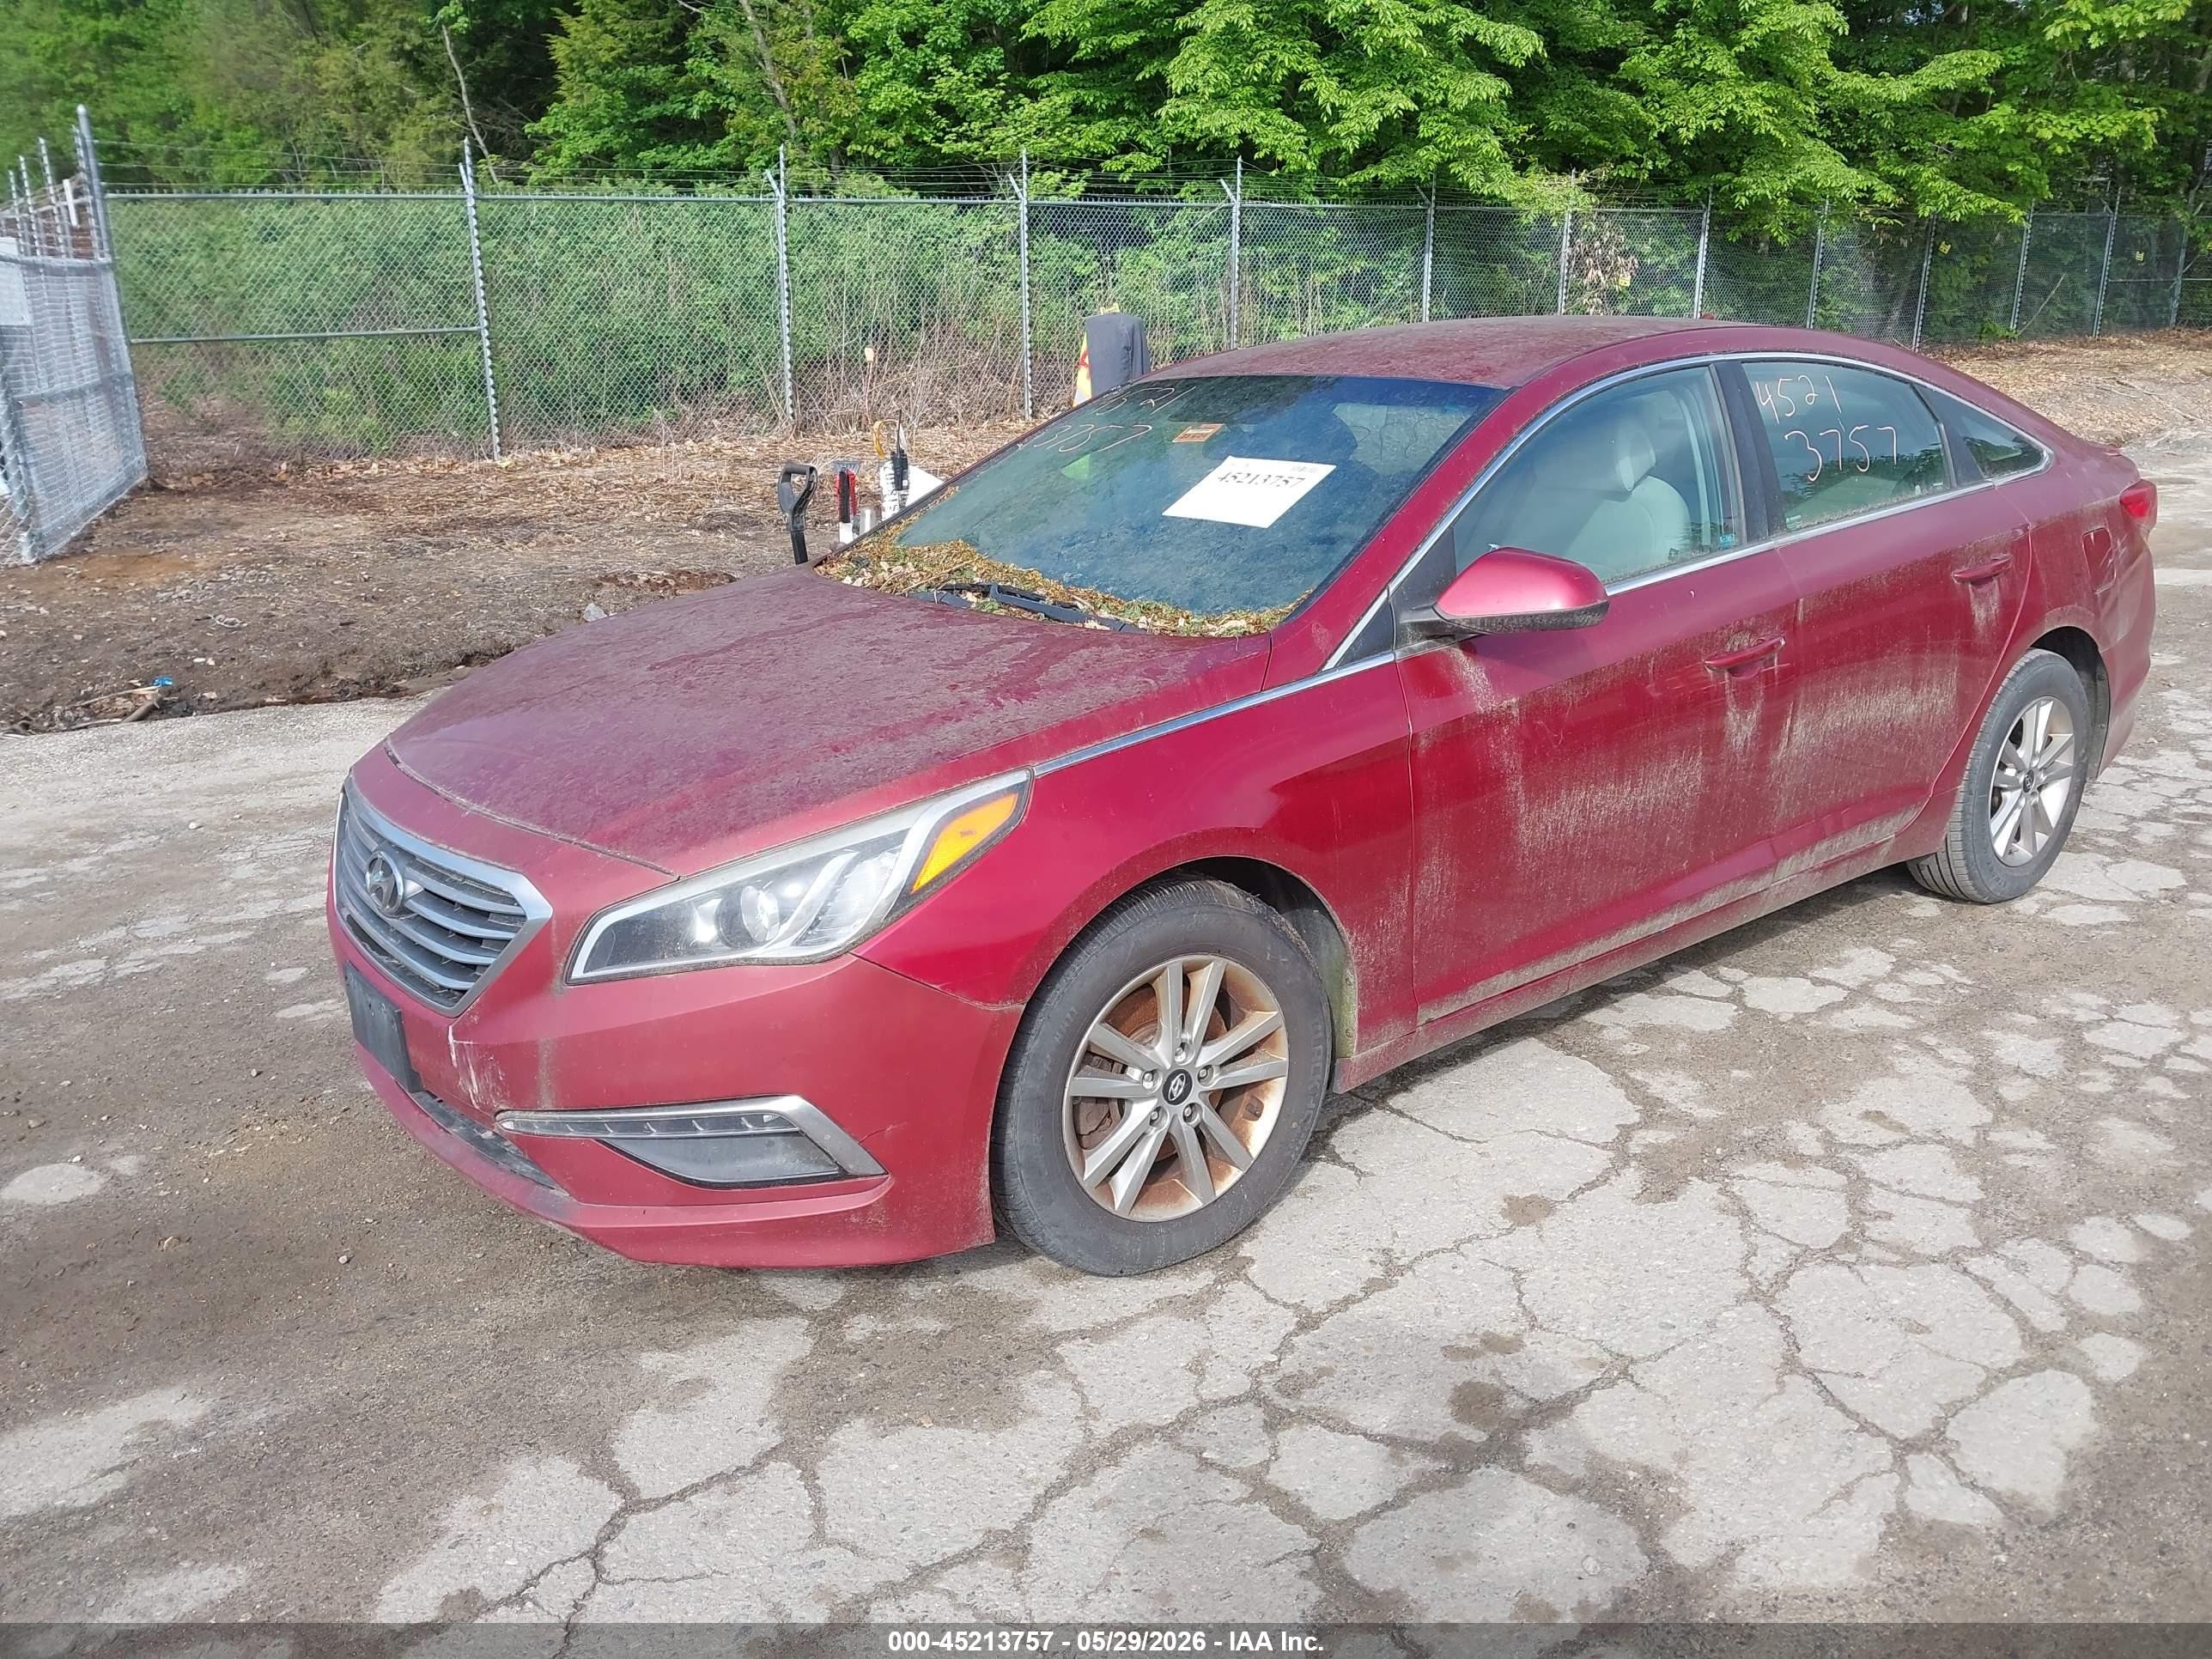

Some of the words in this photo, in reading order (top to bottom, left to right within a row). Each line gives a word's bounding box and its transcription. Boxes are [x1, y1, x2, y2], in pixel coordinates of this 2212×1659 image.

[1755, 374, 1842, 425] 4521
[1784, 424, 1898, 483] 3757
[1217, 471, 1306, 488] 45213757
